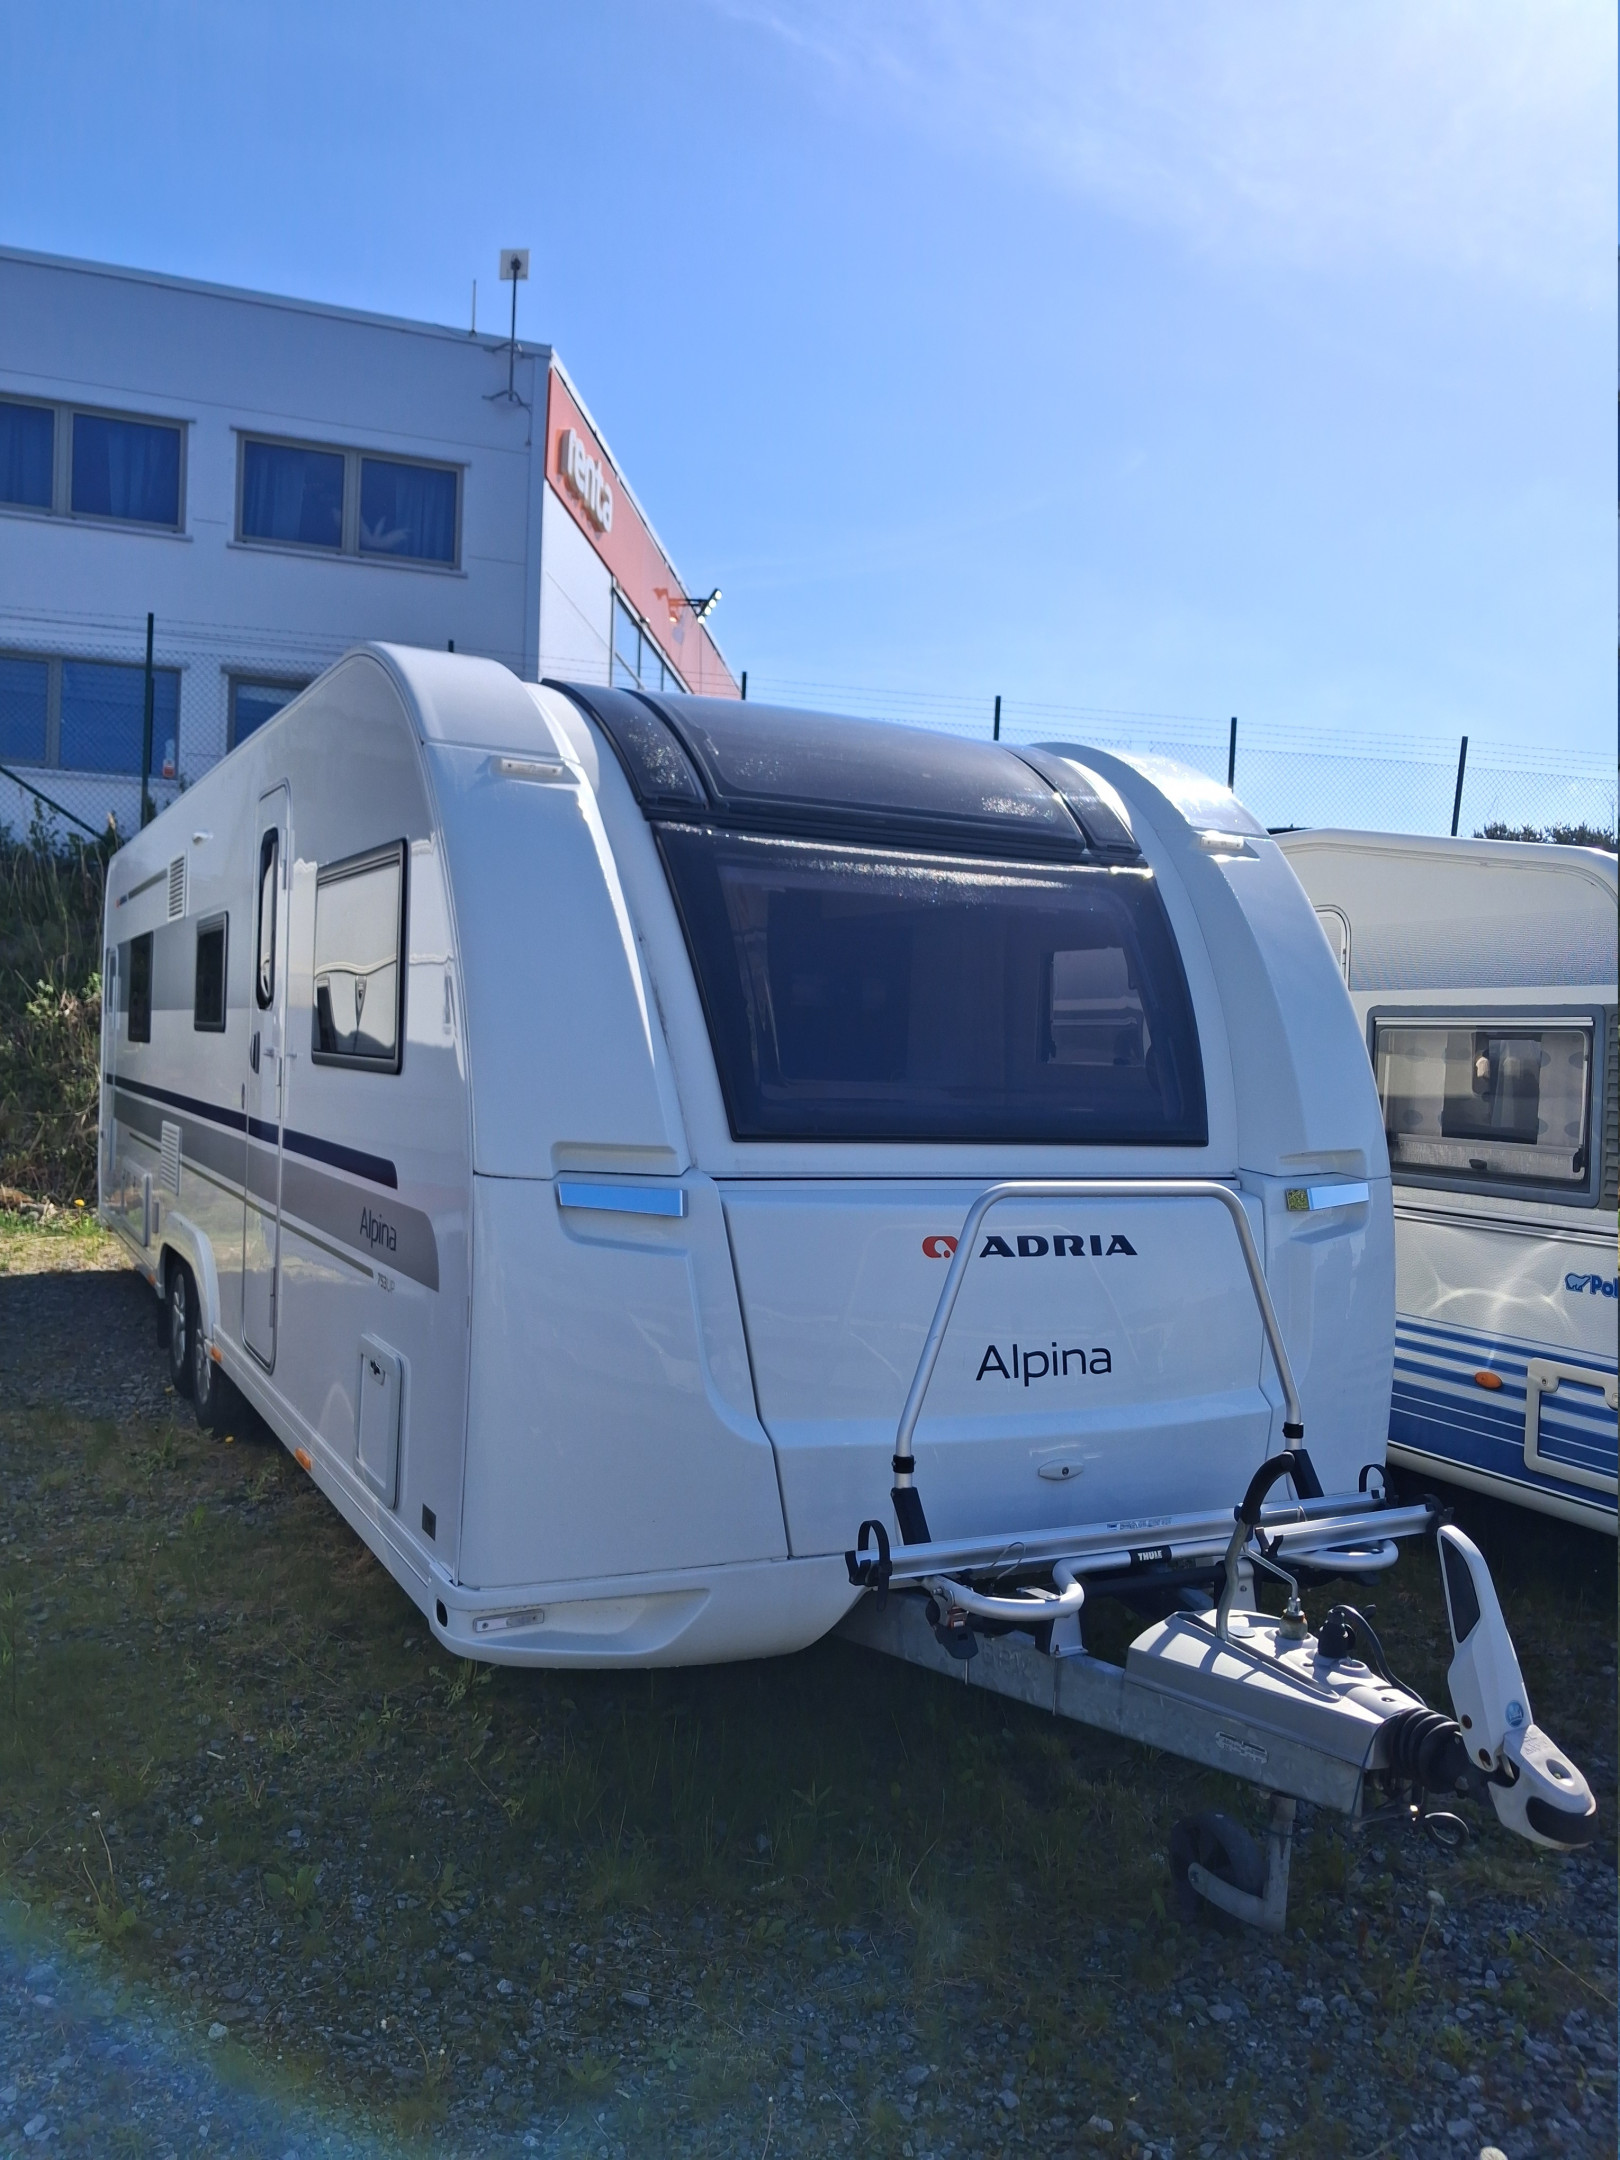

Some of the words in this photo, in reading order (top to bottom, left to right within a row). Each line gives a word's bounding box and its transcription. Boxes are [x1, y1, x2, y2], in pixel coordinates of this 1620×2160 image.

[567, 428, 613, 533] renta
[360, 1206, 397, 1252] Alpina
[979, 1235, 1138, 1258] ADRIA
[976, 1341, 1112, 1387] Alpina
[1137, 1550, 1163, 1561] THULE
